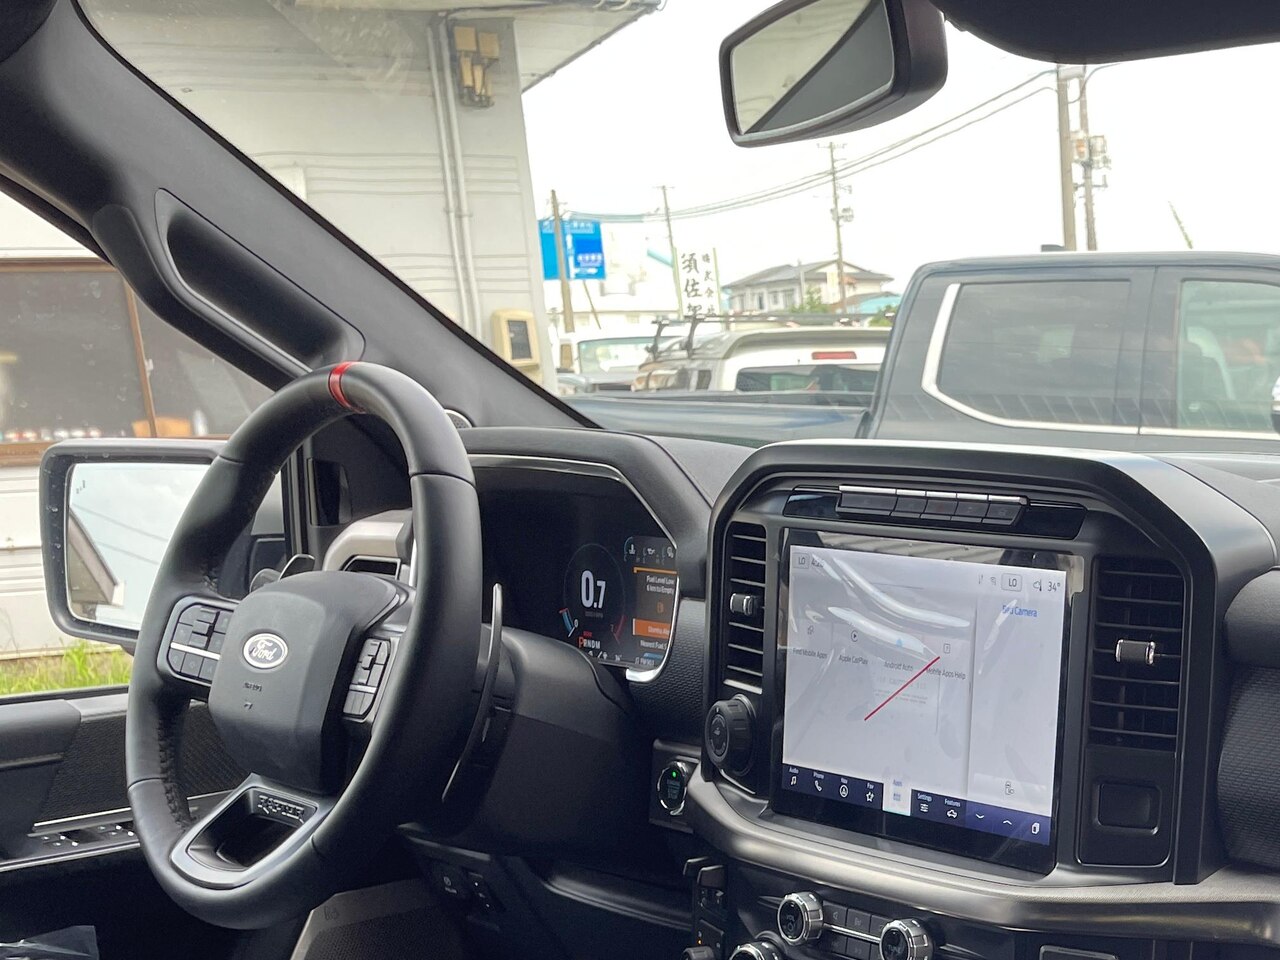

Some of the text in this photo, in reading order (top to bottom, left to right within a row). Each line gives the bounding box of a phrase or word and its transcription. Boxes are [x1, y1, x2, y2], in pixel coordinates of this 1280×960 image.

[1008, 578, 1018, 587] LO
[581, 570, 606, 608] 0.7
[1014, 606, 1038, 617] Camera
[249, 637, 281, 664] Ford
[838, 654, 868, 665] Apple CarPlay
[884, 661, 914, 672] Android Auto
[942, 669, 954, 679] Apps
[954, 670, 966, 680] Help
[917, 792, 932, 802] Settings
[944, 798, 961, 808] Features
